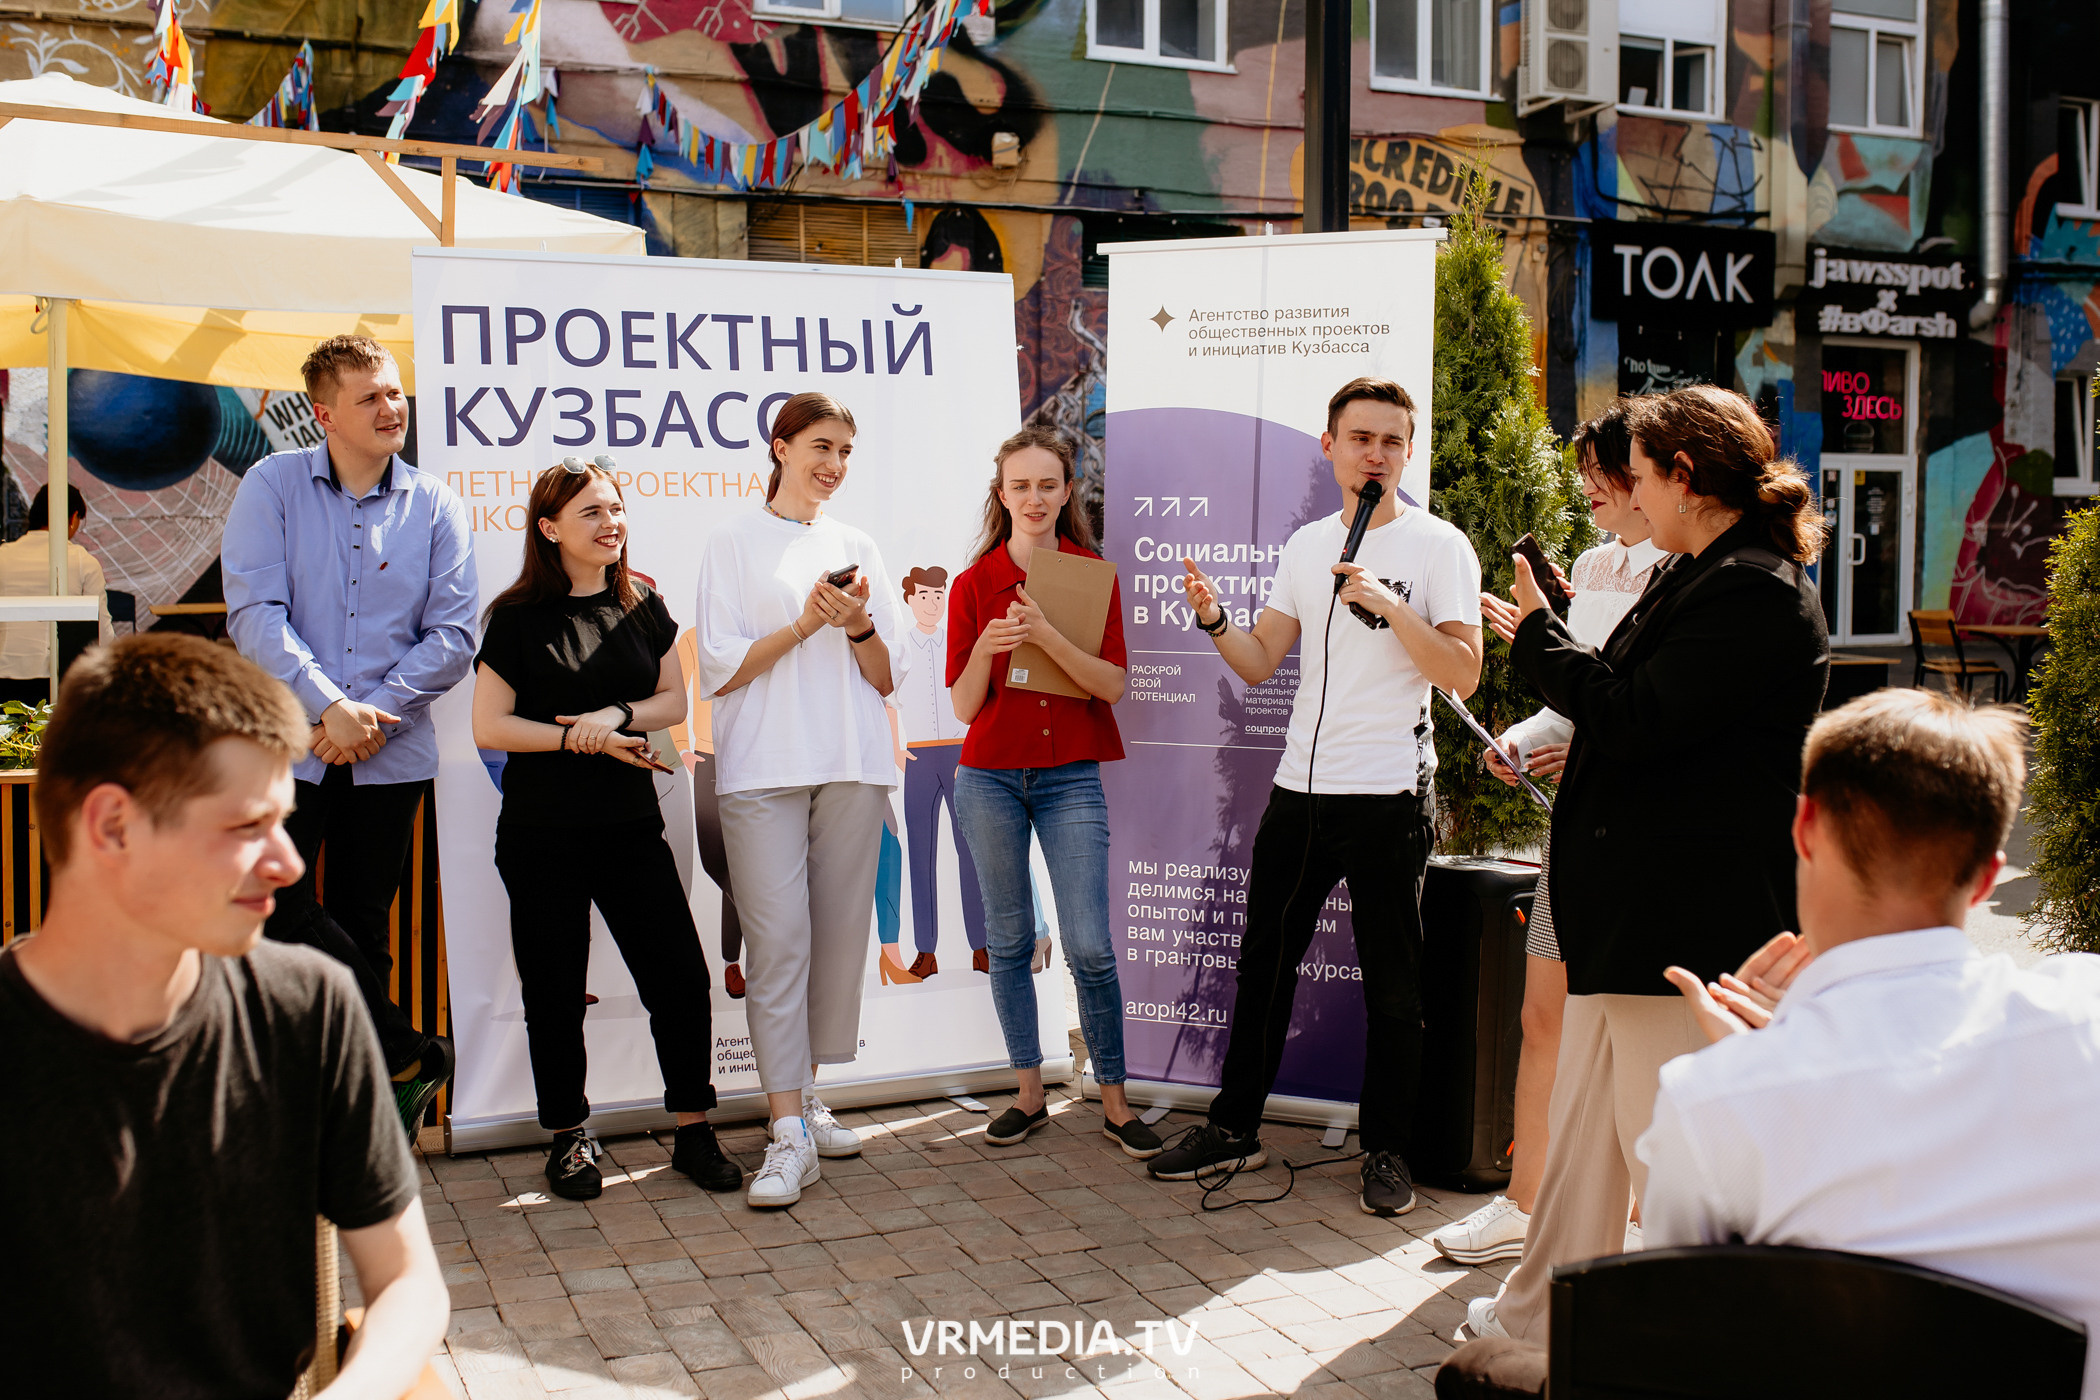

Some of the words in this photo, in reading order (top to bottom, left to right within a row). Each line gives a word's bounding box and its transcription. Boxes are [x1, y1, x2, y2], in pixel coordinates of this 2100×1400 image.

[1808, 247, 1966, 296] jawsspot
[1188, 308, 1270, 323] Агентство
[1274, 306, 1351, 323] развития
[441, 303, 934, 376] ПРОЕКТНЫЙ
[1188, 325, 1308, 342] общественных
[1312, 323, 1391, 339] проектов
[1188, 346, 1198, 357] и
[1202, 344, 1288, 359] инициатив
[1291, 340, 1371, 358] Кузбасса
[1842, 394, 1903, 421] ЗДЕСЬ
[446, 469, 548, 498] ЛЕТН
[615, 471, 773, 498] РОЕКТНА
[1134, 536, 1284, 564] Социальн
[1133, 574, 1274, 602] проктир
[1133, 605, 1150, 625] в
[1131, 664, 1182, 676] РАСКРОЙ
[1131, 677, 1162, 689] СВОЙ
[1245, 687, 1298, 697] социально
[1130, 691, 1196, 704] ПОТЕНЦИАЛ
[1245, 706, 1289, 716] проектов
[1244, 724, 1289, 735] соцпрое
[1128, 860, 1158, 876] мы
[1165, 862, 1251, 886] реализу
[1127, 882, 1216, 902] делимся
[1127, 904, 1206, 923] опытом
[1213, 910, 1225, 925] и
[1127, 925, 1165, 942] вам
[1172, 929, 1242, 947] участв
[1127, 947, 1139, 961] в
[1145, 949, 1242, 970] грантовы
[1125, 1000, 1228, 1024] aropi42.ru
[715, 1036, 751, 1048] Агент
[716, 1049, 757, 1062] общес
[718, 1065, 727, 1075] и
